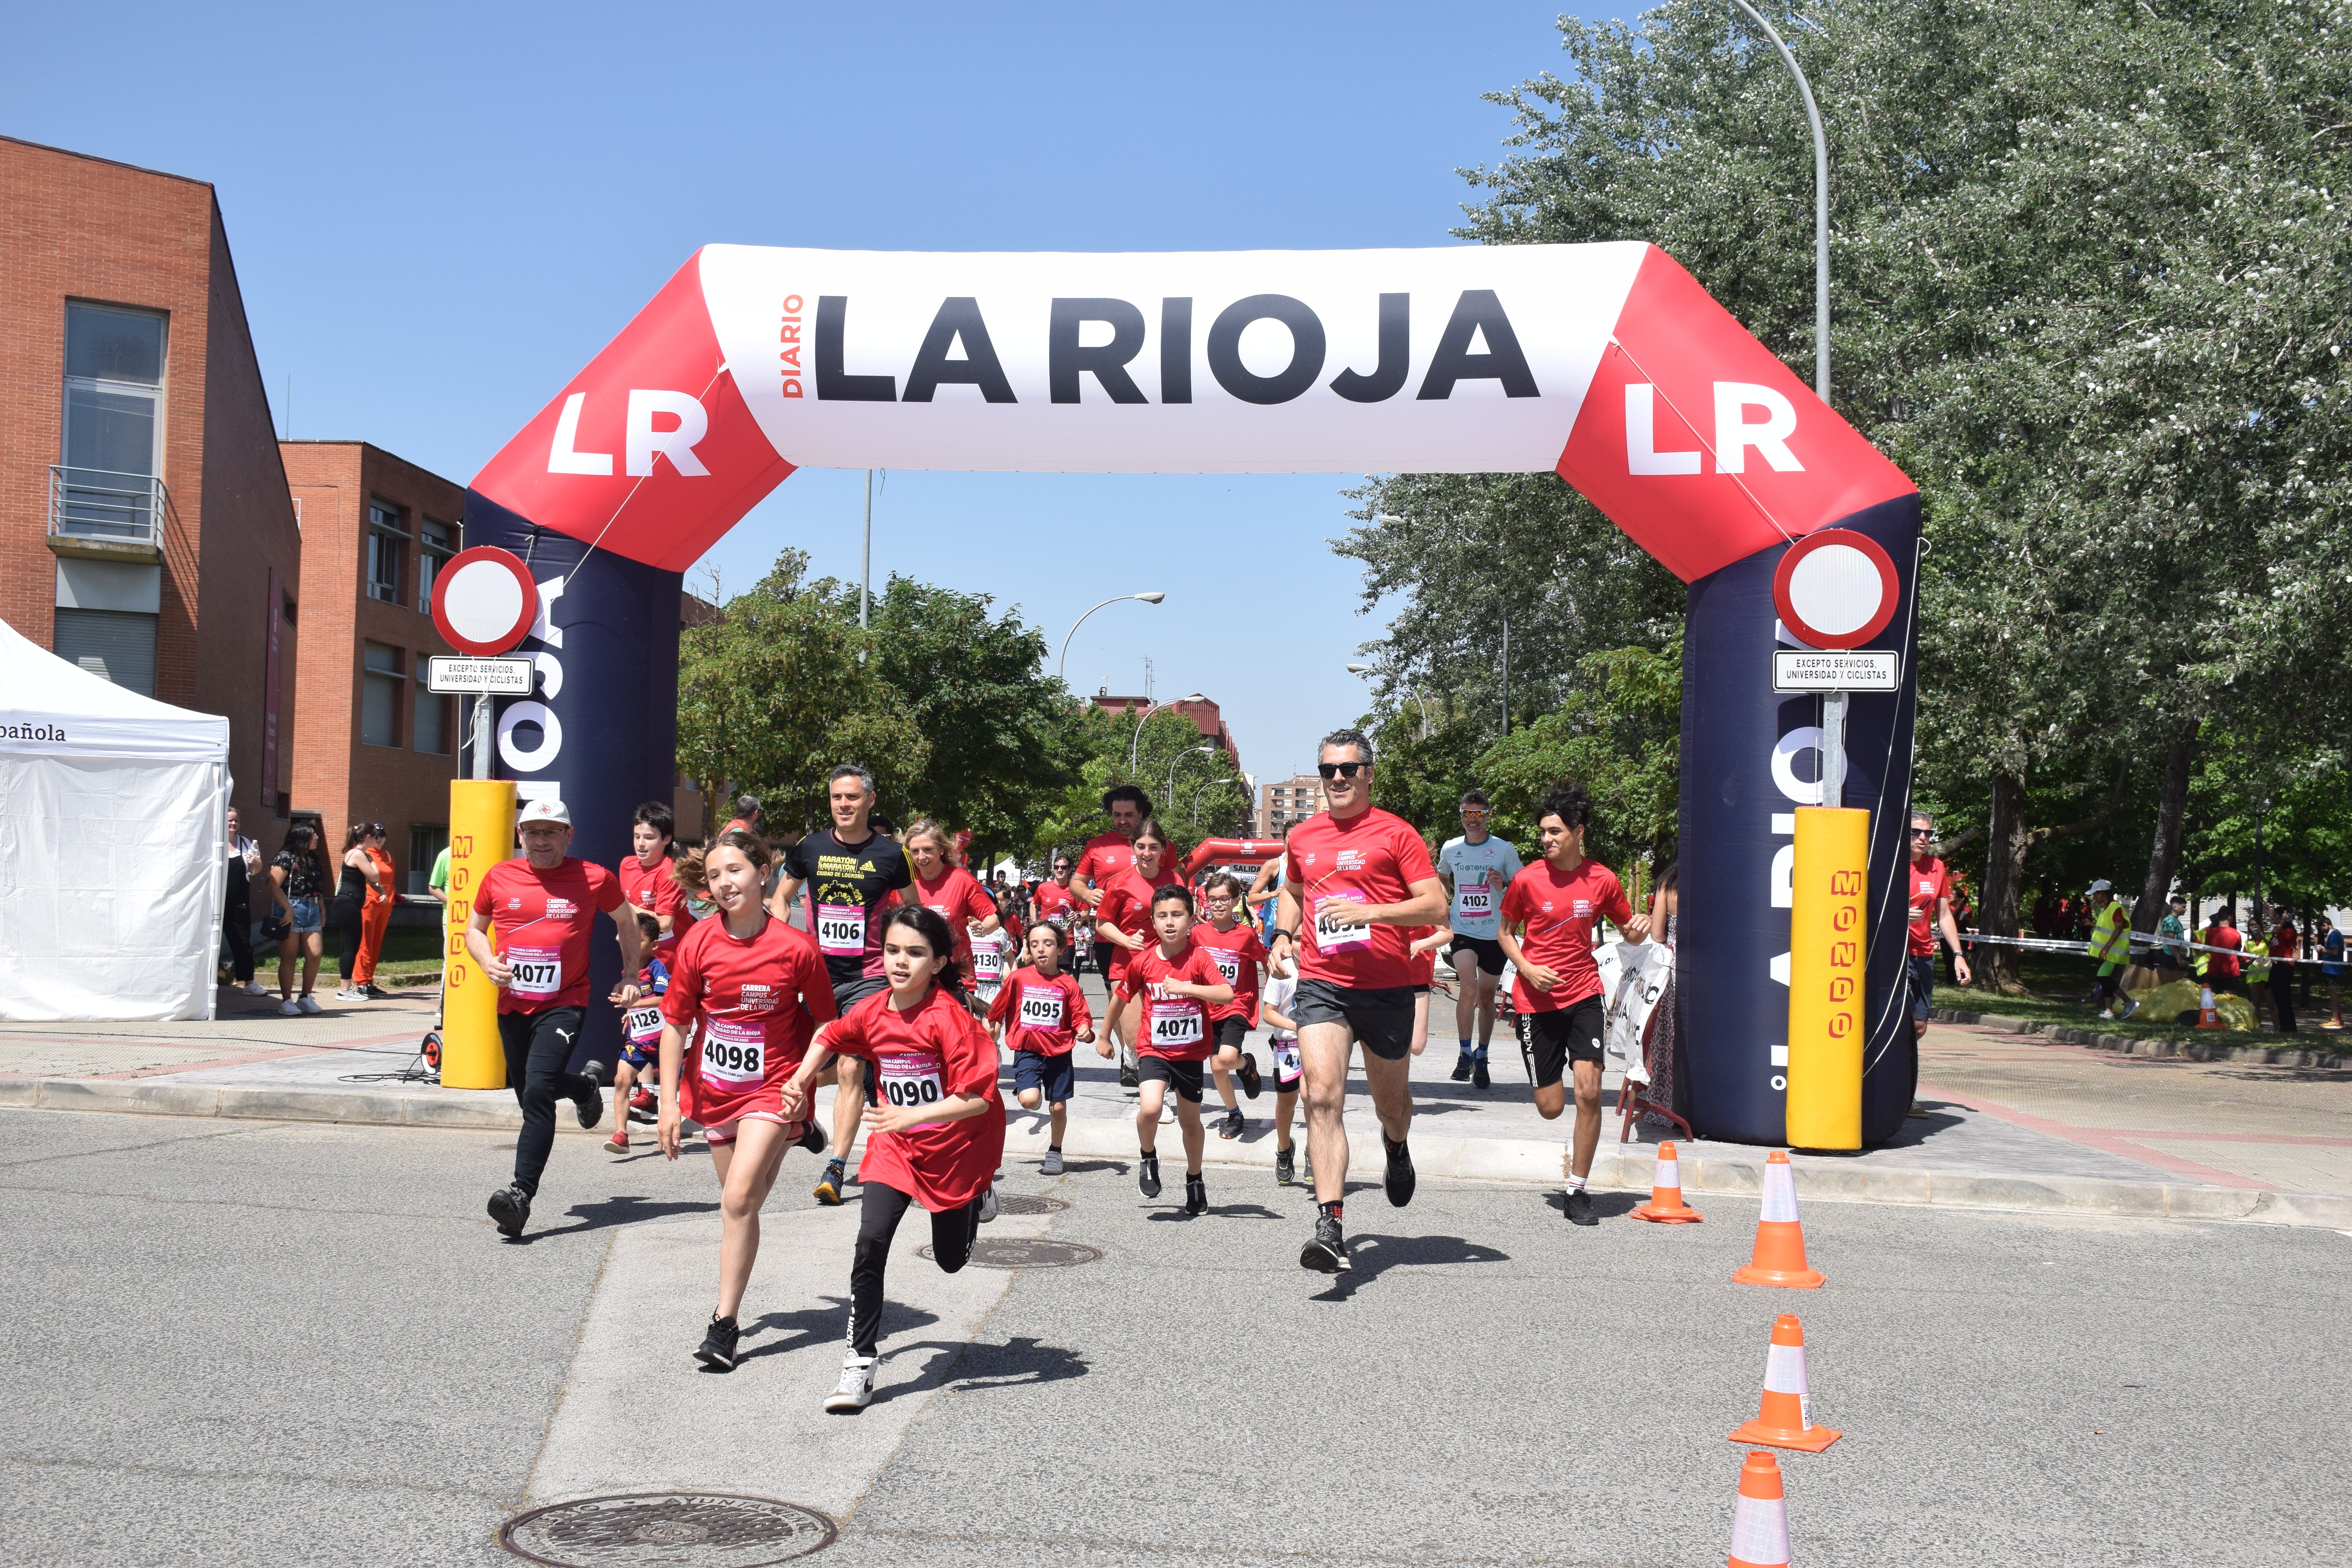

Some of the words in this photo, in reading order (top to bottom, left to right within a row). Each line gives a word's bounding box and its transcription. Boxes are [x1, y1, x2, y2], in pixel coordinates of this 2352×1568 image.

[781, 294, 804, 399] DIARIO
[815, 295, 1019, 404] LA
[1049, 289, 1541, 405] RIOJA
[548, 389, 711, 477] LR
[1625, 381, 1806, 475] LR
[449, 664, 477, 673] EXCEPTO
[480, 665, 515, 674] SERVICIOS,
[1797, 659, 1831, 668] EXCEPTO
[1835, 659, 1877, 669] SERVICIOS,
[440, 674, 482, 683] UNIVERSIDAD
[490, 675, 523, 684] CICLISTAS
[1786, 671, 1837, 679] UNIVERSIDAD
[1839, 671, 1844, 679] Y
[1847, 671, 1887, 680] CICLISTAS
[819, 855, 857, 865] MARATÓN
[1462, 895, 1488, 907] 4102
[450, 836, 473, 988] MONDO
[822, 922, 860, 940] 4106
[1319, 915, 1366, 935] 40
[974, 954, 998, 967] 4130
[1829, 871, 1861, 1038] MONDO
[511, 964, 556, 983] 4077
[1023, 1000, 1060, 1018] 4095
[1156, 1018, 1197, 1037] 4071
[1522, 1018, 1533, 1052] ADIDAS
[705, 1039, 759, 1072] 4098
